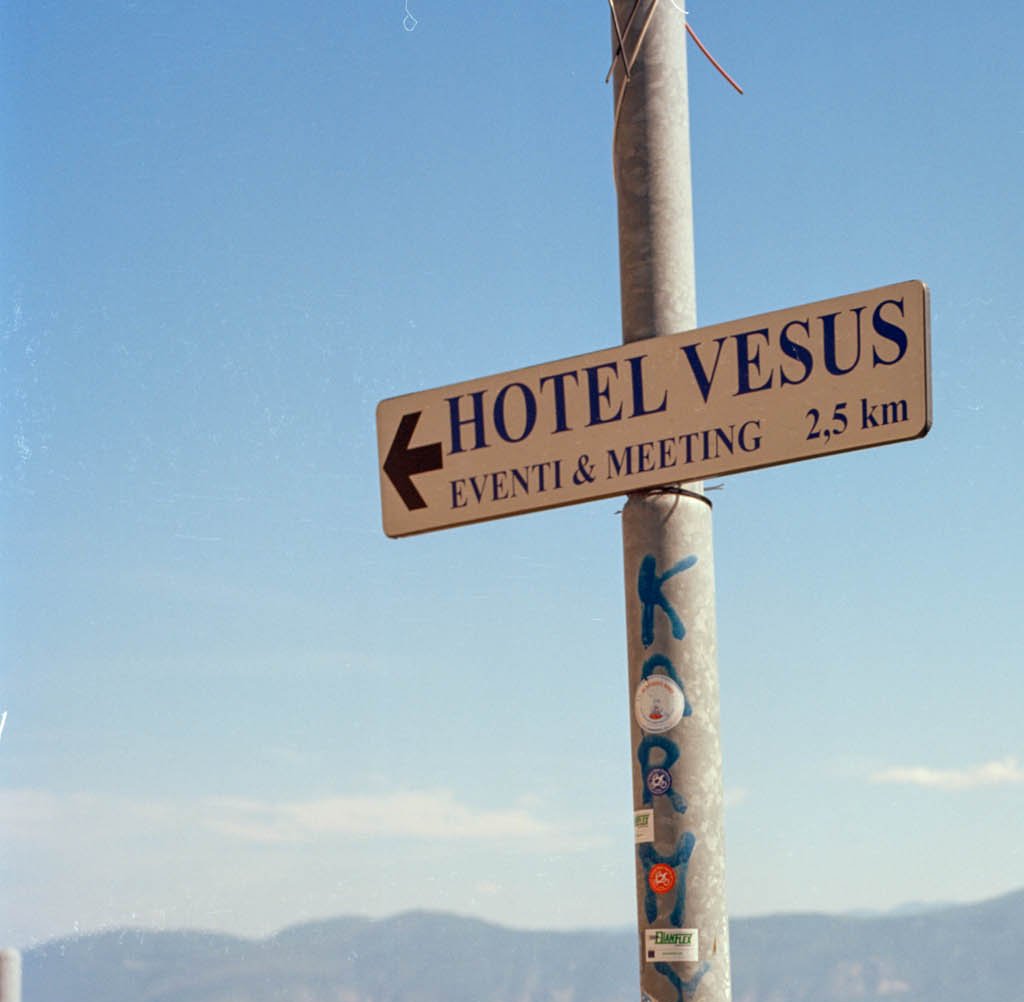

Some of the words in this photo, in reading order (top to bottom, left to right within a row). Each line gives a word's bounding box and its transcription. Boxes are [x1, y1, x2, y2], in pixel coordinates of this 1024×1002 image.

[444, 355, 668, 454] HOTEL
[680, 297, 909, 403] VESUS
[450, 461, 562, 510] EVENTI
[572, 454, 595, 486] &
[606, 420, 762, 480] MEETING
[805, 401, 849, 447] 2,5
[861, 395, 909, 430] km
